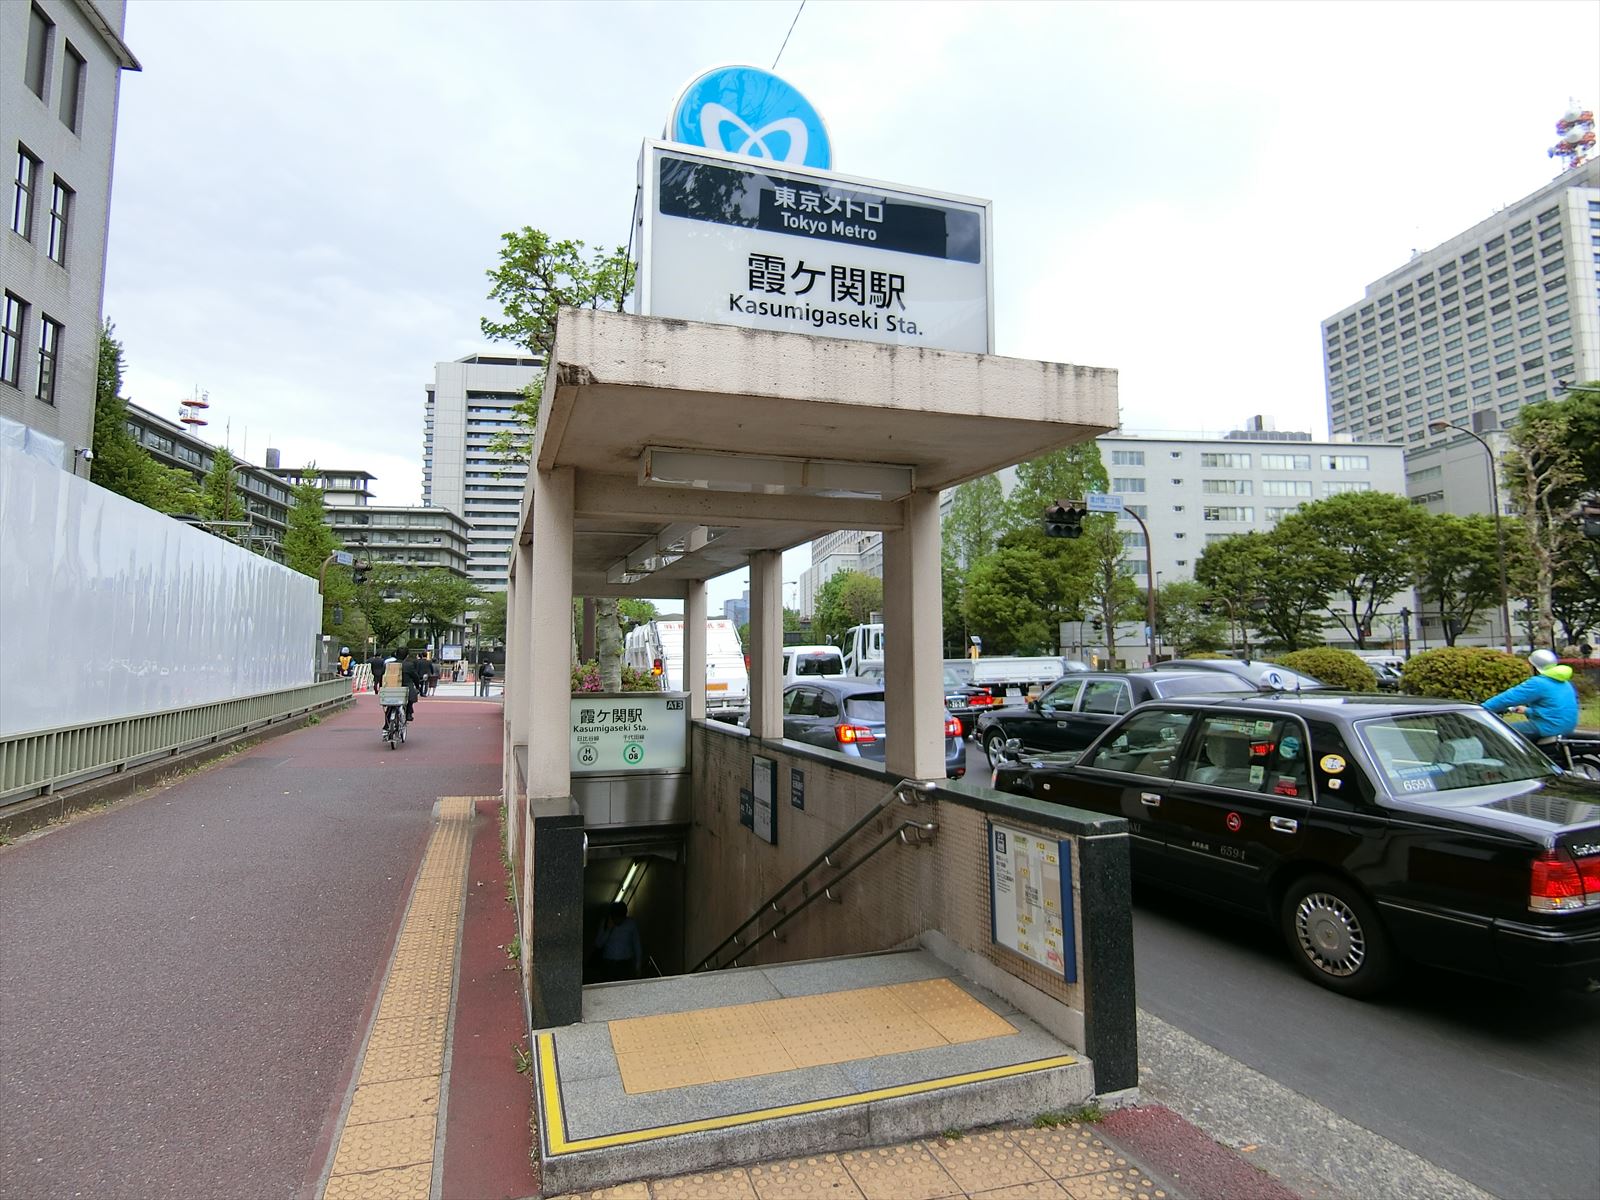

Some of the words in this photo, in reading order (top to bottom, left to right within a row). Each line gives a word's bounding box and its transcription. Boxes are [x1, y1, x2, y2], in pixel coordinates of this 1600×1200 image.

[774, 186, 884, 224] 東京メトロ
[781, 211, 828, 235] Tokyo
[831, 222, 877, 241] Metro
[748, 252, 906, 311] 霞ケ関駅
[729, 293, 879, 330] Kasumigaseki
[886, 314, 923, 336] Sta.
[580, 708, 643, 724] 霞ケ関駅
[667, 701, 683, 710] A13
[573, 724, 631, 734] Kasumigaseki
[633, 724, 649, 732] Sta.
[582, 754, 593, 762] 06
